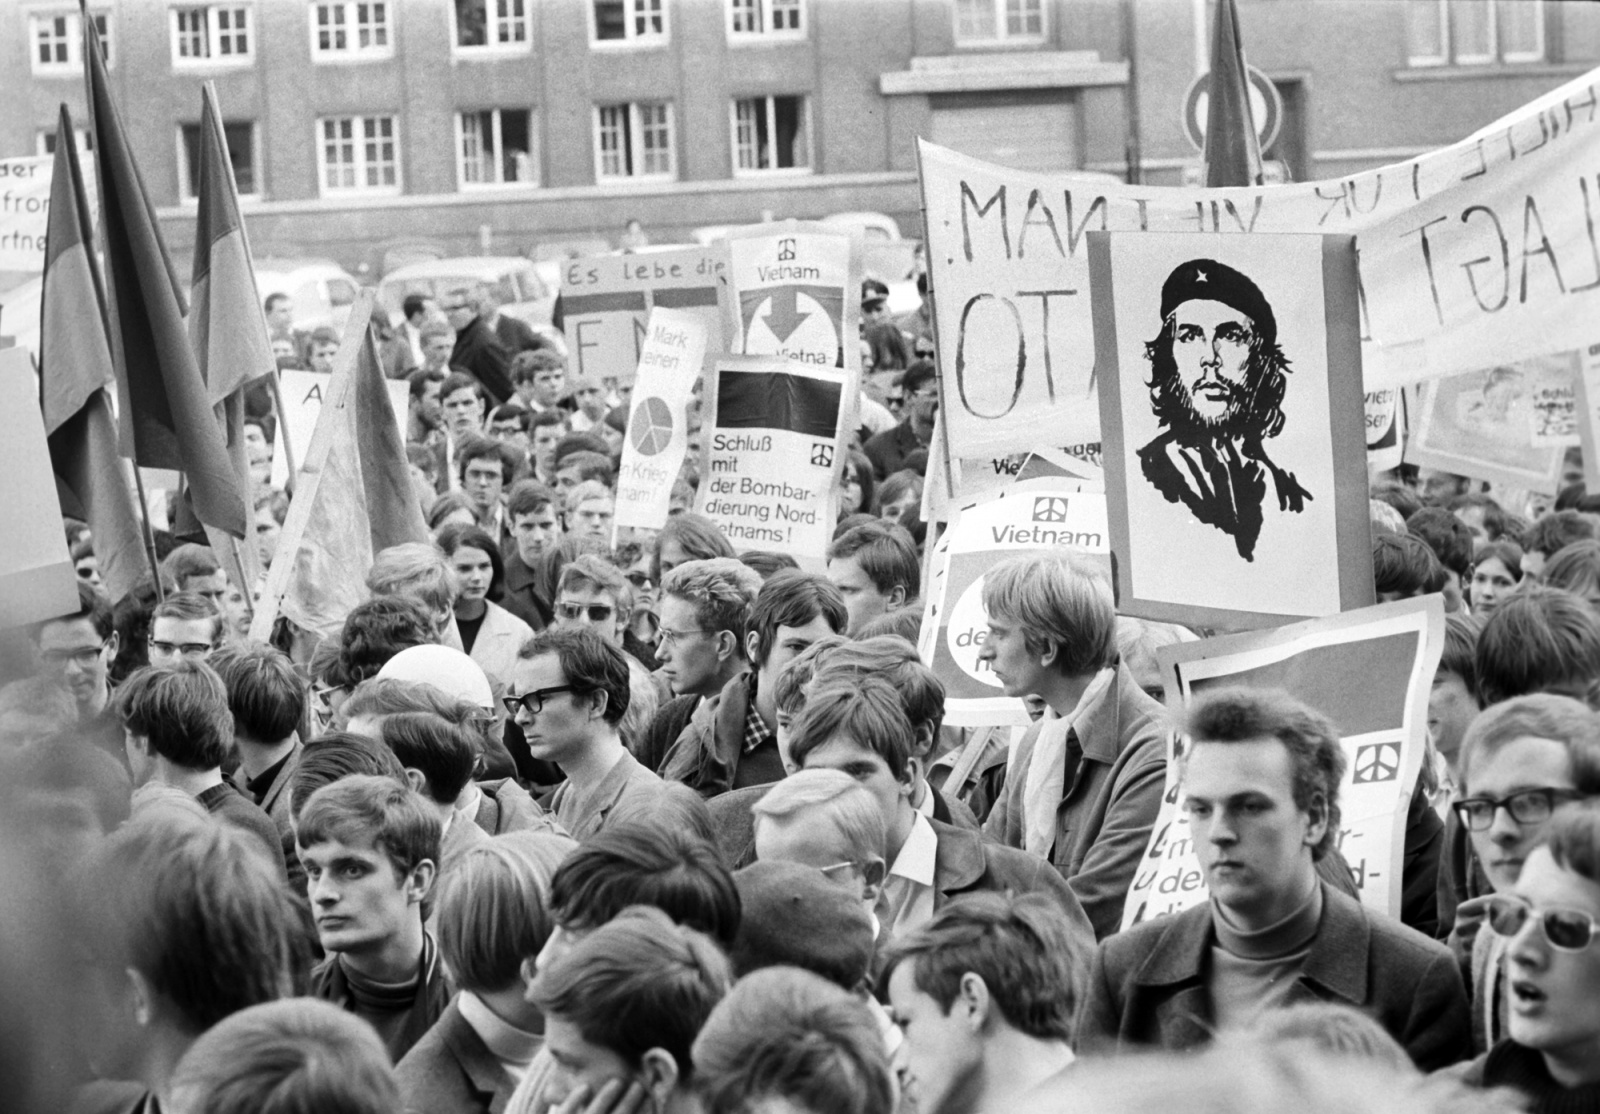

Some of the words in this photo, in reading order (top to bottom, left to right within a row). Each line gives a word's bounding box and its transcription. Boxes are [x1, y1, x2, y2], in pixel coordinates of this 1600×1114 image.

[568, 264, 599, 285] Es
[623, 261, 682, 280] lebe
[696, 257, 726, 276] die
[758, 265, 820, 282] Vietnam
[652, 326, 688, 348] Mark
[713, 434, 772, 452] Schluß
[632, 462, 669, 486] Krieg
[711, 456, 738, 473] mit
[710, 478, 736, 494] der
[740, 477, 817, 501] Bombar-
[705, 498, 770, 523] dierung
[775, 503, 824, 525] Nord-
[991, 525, 1102, 548] Vietnam
